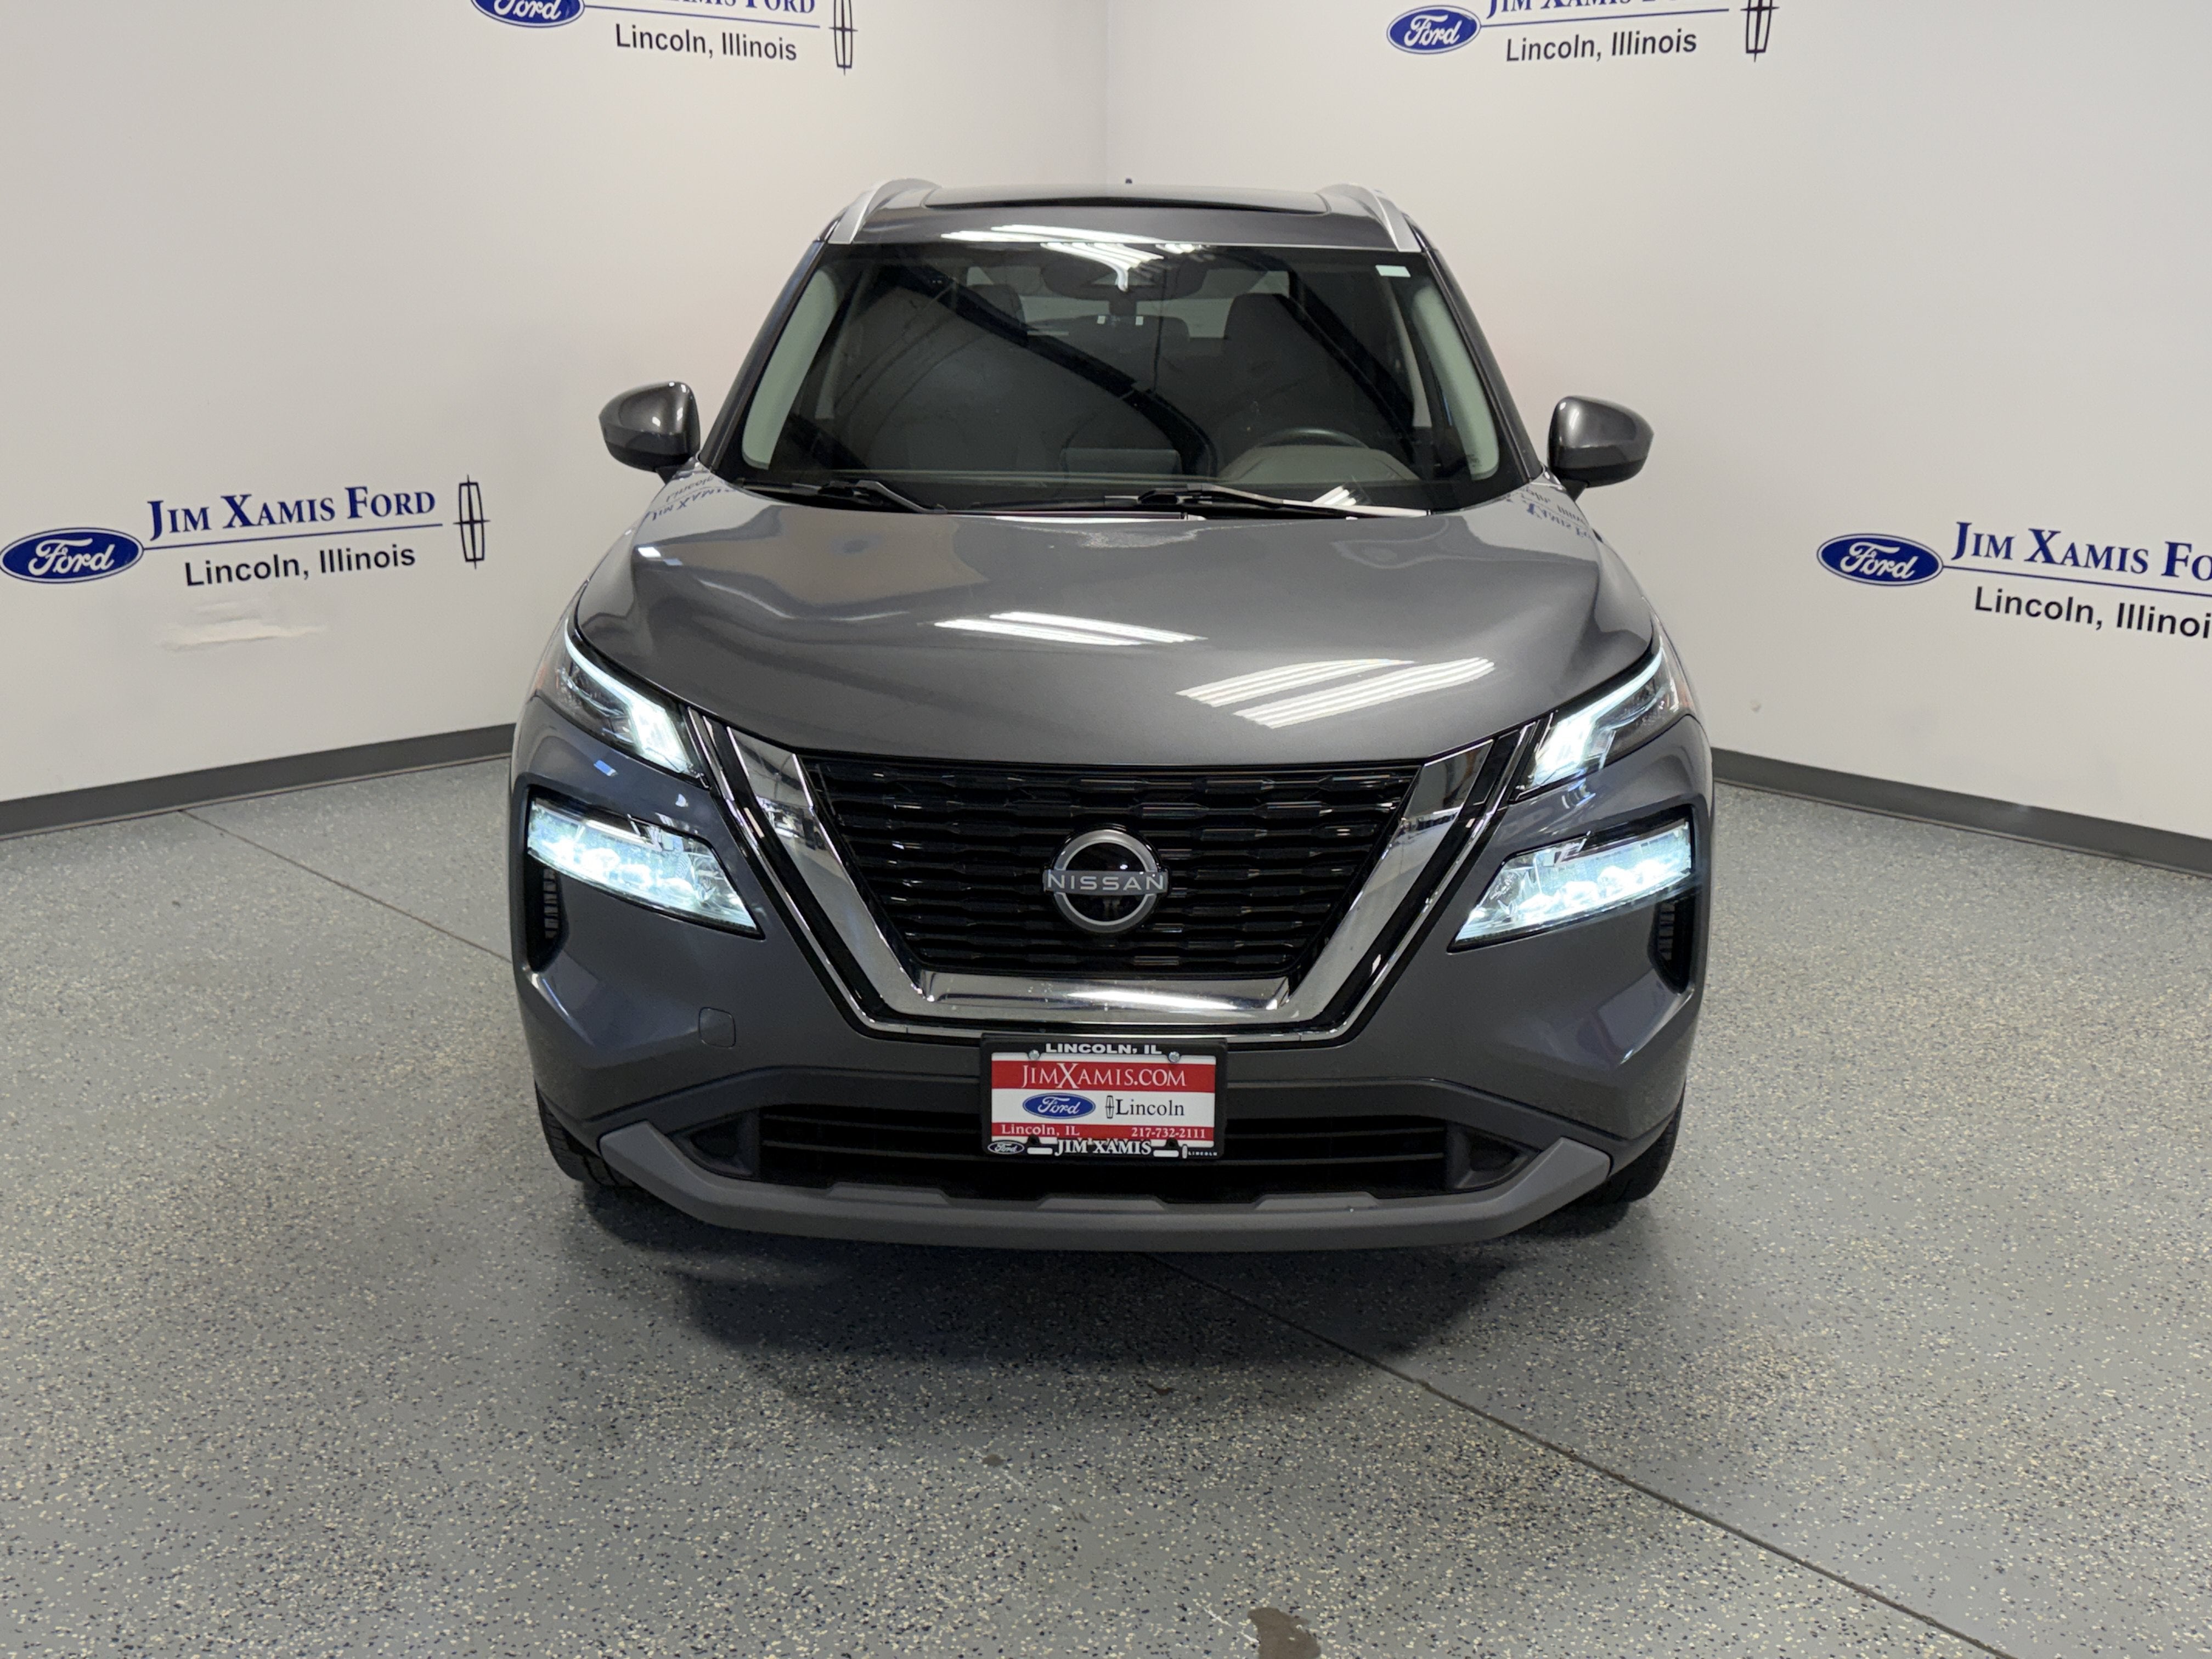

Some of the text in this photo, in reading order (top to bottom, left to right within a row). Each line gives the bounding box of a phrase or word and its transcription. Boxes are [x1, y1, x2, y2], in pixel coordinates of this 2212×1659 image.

[616, 23, 797, 60] Lincoln, Illinois
[1403, 15, 1461, 46] Ford
[1506, 28, 1697, 62] Lincoln, Illinois
[146, 486, 437, 541] JIM XAMIS FORD
[27, 538, 115, 577] Ford
[1839, 541, 1916, 580] Ford
[1951, 521, 2015, 561] JIM
[2024, 528, 2150, 574] XAMIS
[184, 544, 417, 586] Lincoln, Illinois
[1975, 586, 2103, 630] Lincoln,
[1047, 873, 1164, 891] NISSAN
[1045, 1043, 1163, 1055] LINCOLN, IL
[1022, 1063, 1187, 1089] JIMXAMIS.COM
[1037, 1096, 1080, 1115] Ford
[1115, 1099, 1185, 1116] Lincoln
[1001, 1124, 1080, 1136] Lincoln, IL
[1131, 1127, 1206, 1139] 217-732-2111
[1054, 1139, 1152, 1156] JIM XAMIS
